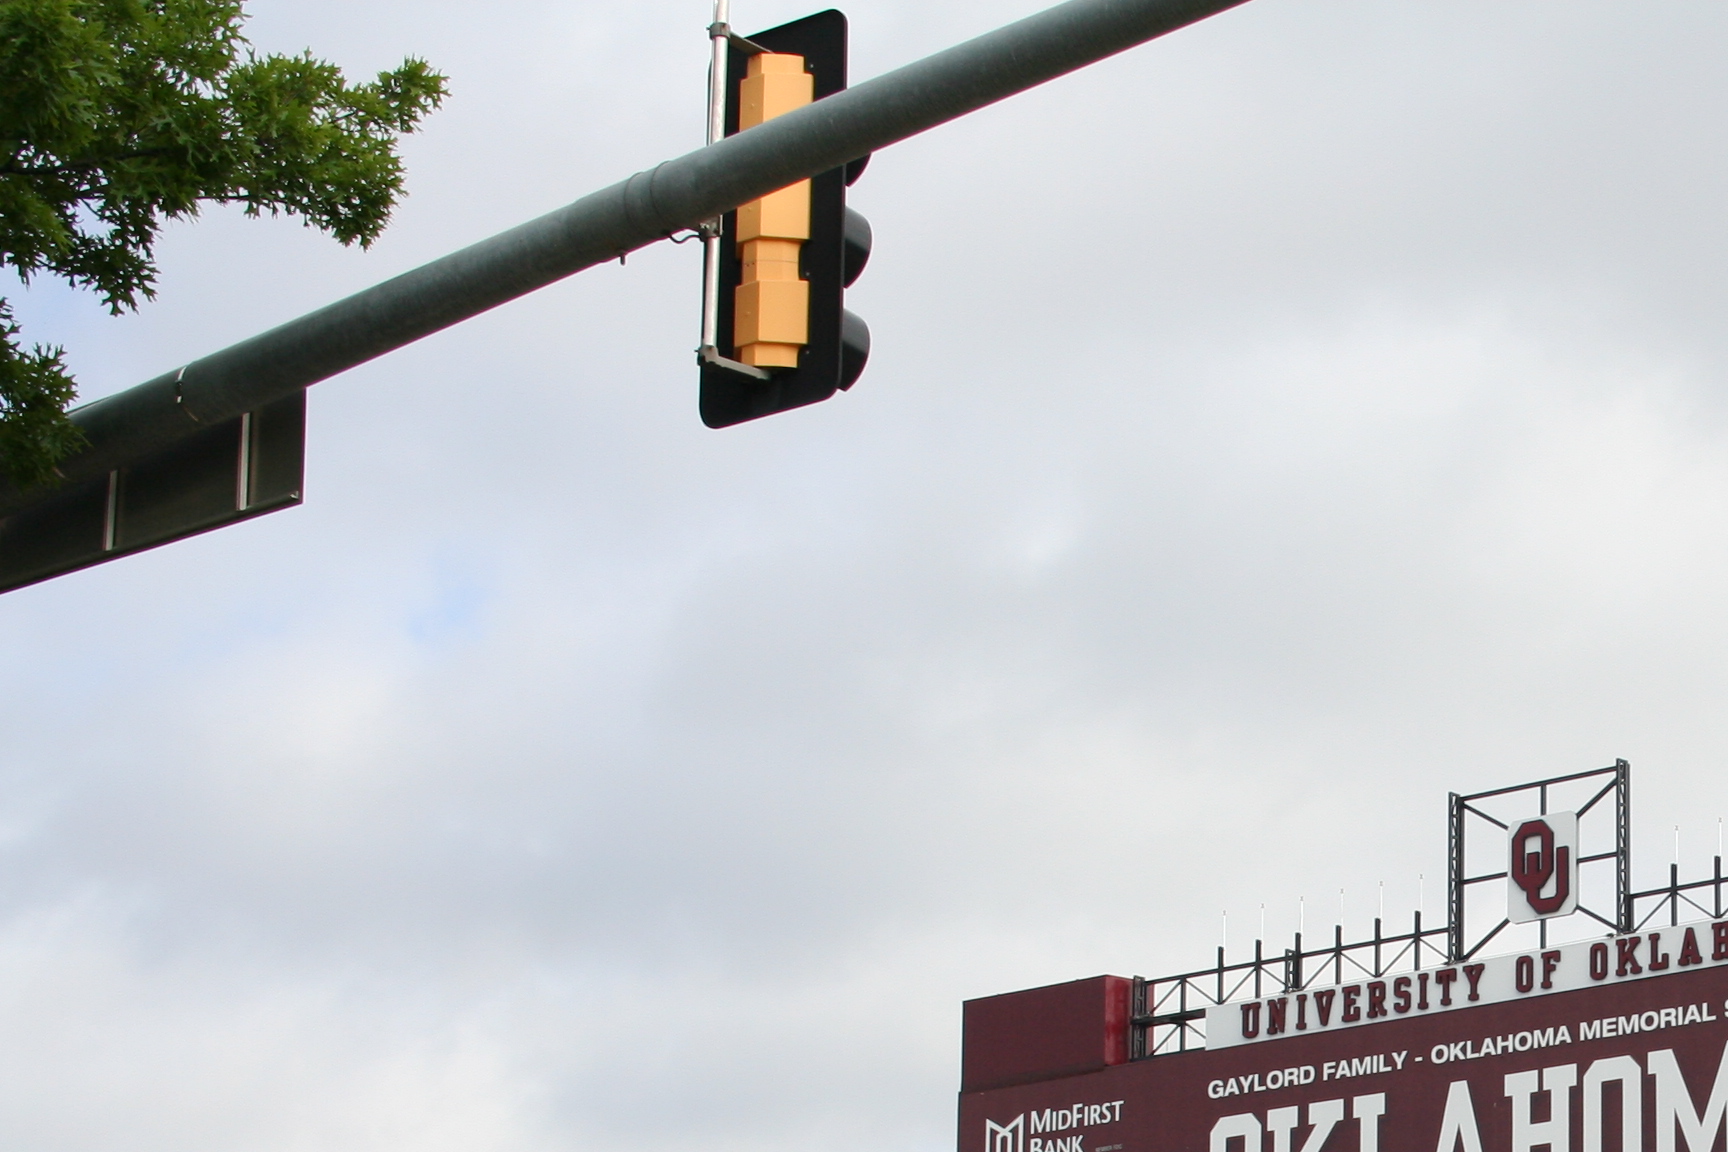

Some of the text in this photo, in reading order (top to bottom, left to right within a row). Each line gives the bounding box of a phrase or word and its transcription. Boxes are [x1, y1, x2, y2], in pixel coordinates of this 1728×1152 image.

[1512, 819, 1569, 915] OU
[1240, 963, 1485, 1039] UNIVERSITY
[1515, 949, 1561, 993] OF
[1208, 1066, 1315, 1098] GAYLORD
[1323, 1051, 1408, 1081] FAMILY
[1431, 1025, 1572, 1064] OKLAHOMA
[1580, 1003, 1717, 1042] MEMORIAL
